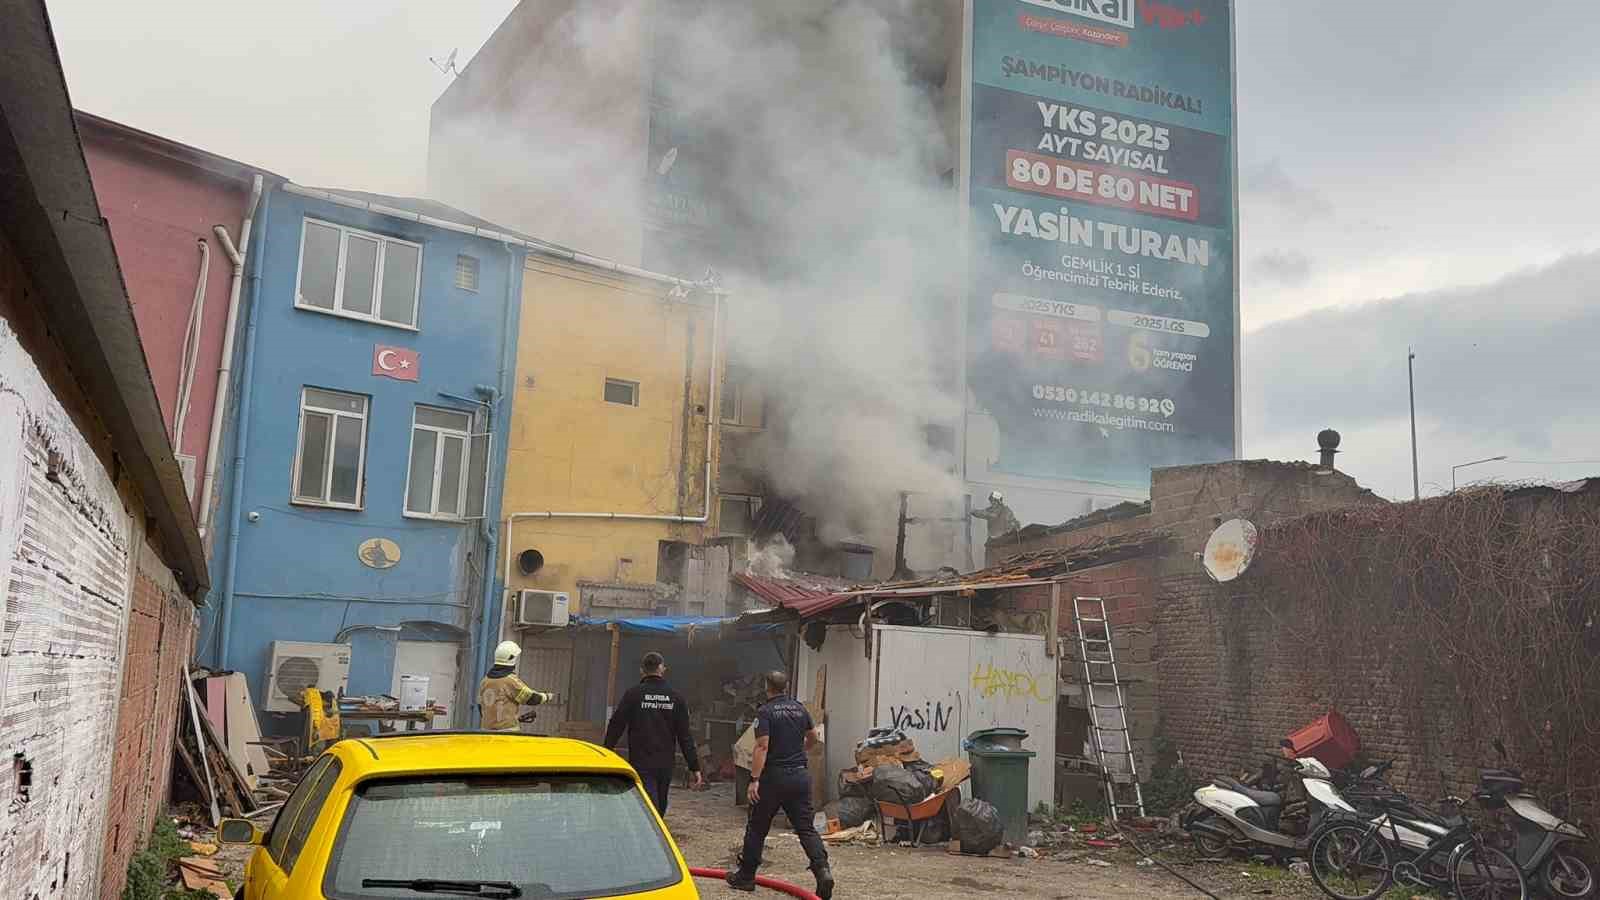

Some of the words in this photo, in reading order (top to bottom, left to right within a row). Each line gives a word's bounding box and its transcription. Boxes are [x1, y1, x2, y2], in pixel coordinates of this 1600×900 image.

[1001, 55, 1109, 96] ŞAMPİYON
[1037, 101, 1097, 137] YKS
[1101, 116, 1170, 151] 2025
[1038, 133, 1081, 156] AYT
[1083, 142, 1169, 174] SAYISAL
[1012, 158, 1051, 186] 80
[1056, 165, 1093, 194] DE
[1099, 172, 1135, 201] 80
[1139, 181, 1193, 212] NET
[992, 202, 1093, 248] YASİN
[1098, 222, 1209, 267] TURAN
[1022, 260, 1100, 287] Öğrencimizi
[1102, 276, 1139, 294] Tebrik
[1061, 255, 1113, 274] GEMLİK
[1052, 302, 1076, 316] YKS
[1134, 314, 1163, 329] 2025
[1164, 318, 1185, 333] LGS
[1138, 397, 1160, 413] 92
